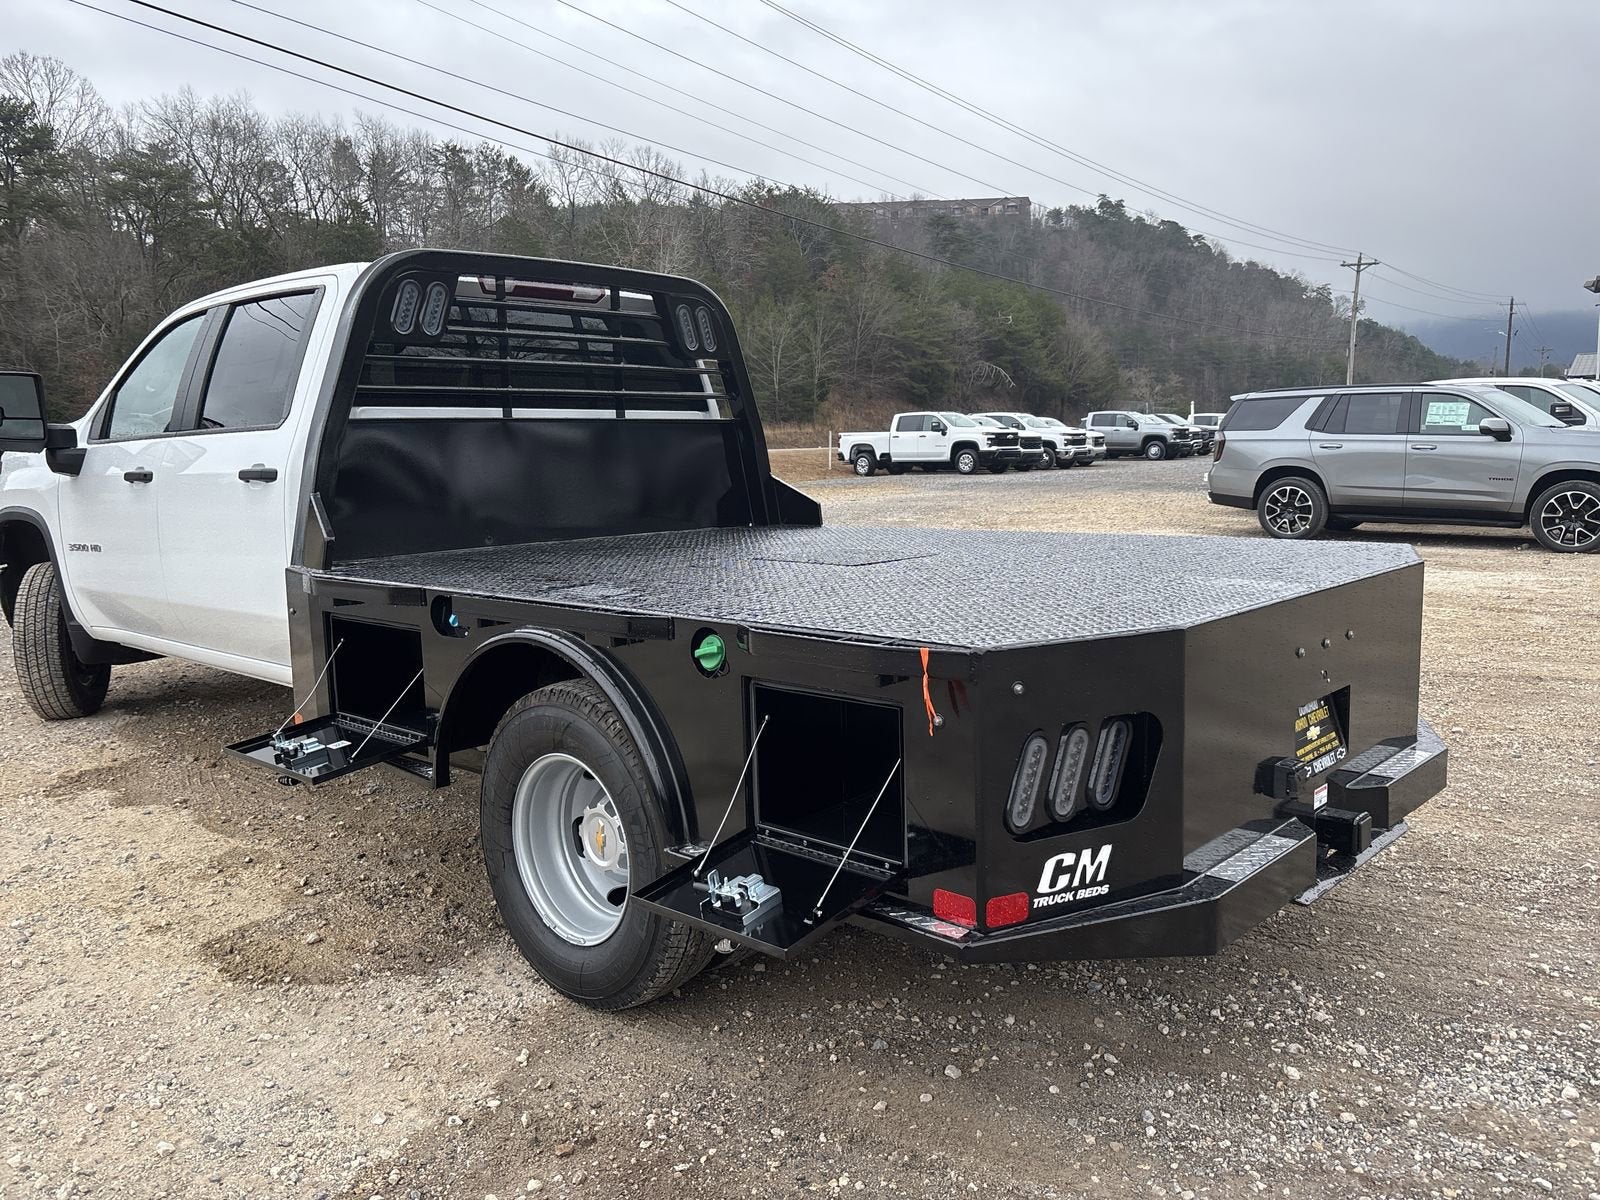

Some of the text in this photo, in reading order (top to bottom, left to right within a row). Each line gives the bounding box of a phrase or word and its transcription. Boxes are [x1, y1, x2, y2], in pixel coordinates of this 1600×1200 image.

[68, 543, 102, 553] 3500 HD
[1307, 706, 1329, 725] CHEVROLET
[1312, 752, 1336, 773] CHEVROLET
[1037, 844, 1112, 893] CM
[1033, 884, 1110, 909] TRUCK BEDS
